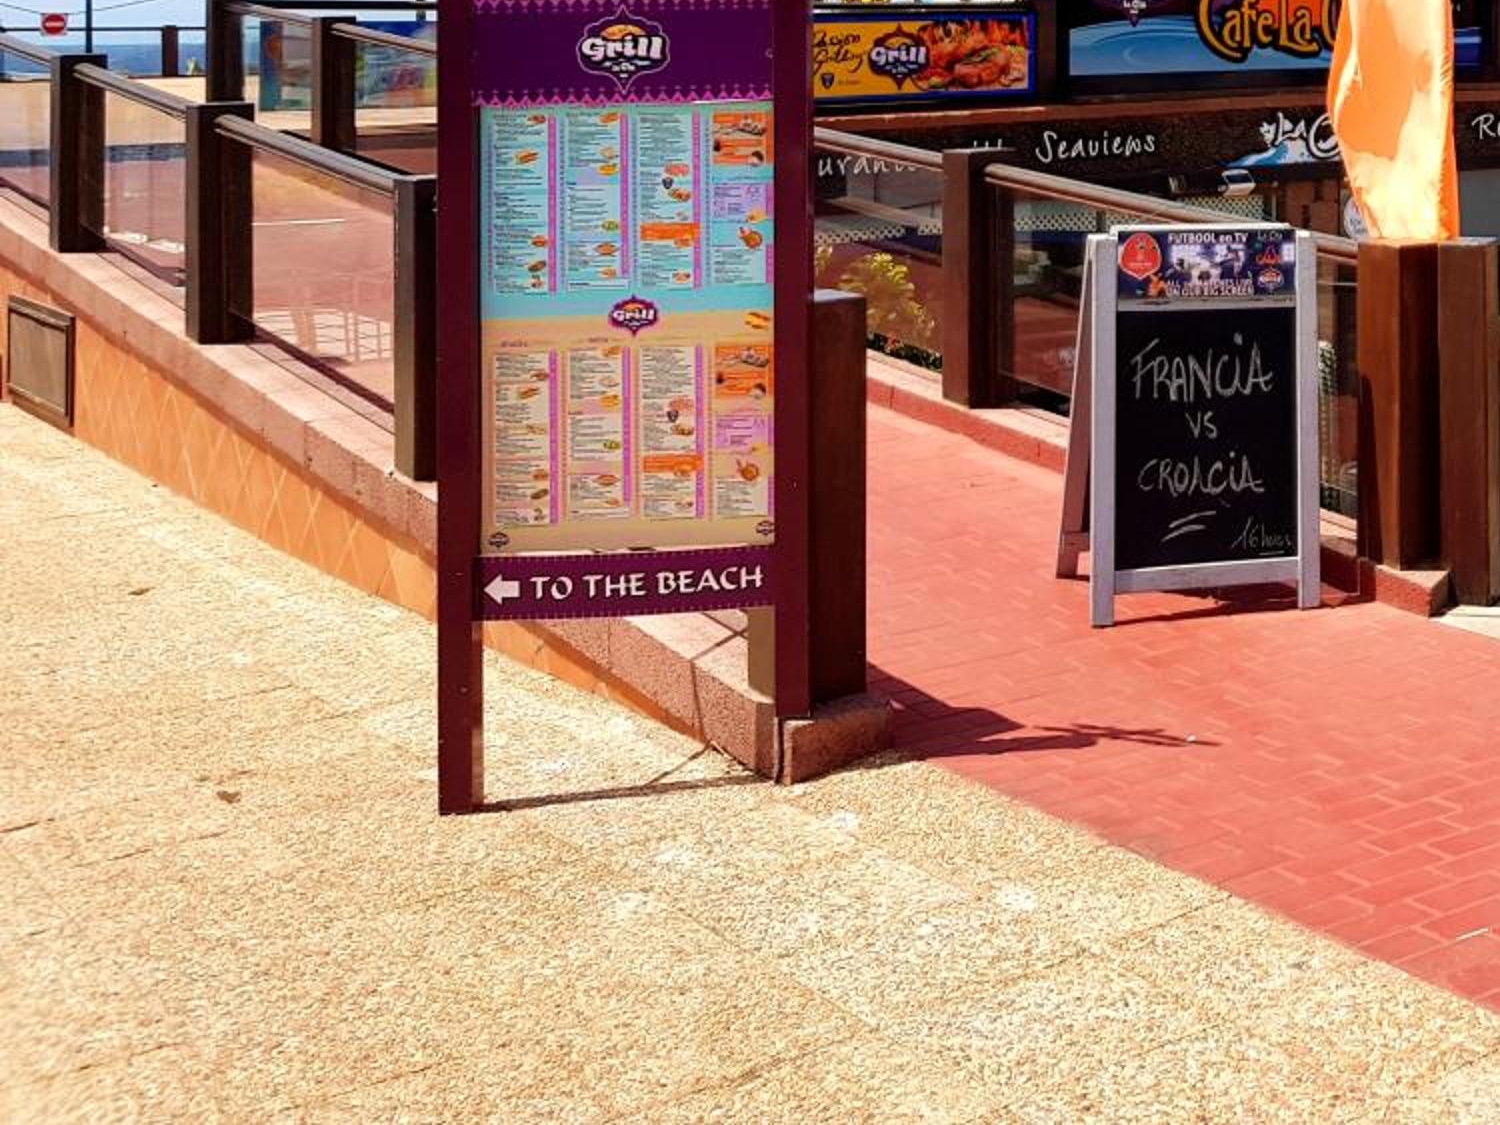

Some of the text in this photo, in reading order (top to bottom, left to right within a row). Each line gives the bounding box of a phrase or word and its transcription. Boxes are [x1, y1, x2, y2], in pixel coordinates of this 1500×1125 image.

[581, 35, 662, 62] Grill
[1035, 130, 1156, 163] Seaviews
[1219, 234, 1232, 244] en
[1234, 232, 1248, 244] TV
[611, 309, 656, 322] Grill
[1130, 332, 1273, 403] FRANCIA
[1137, 451, 1265, 497] CROACIA
[530, 565, 763, 600] TO THE BEACH
